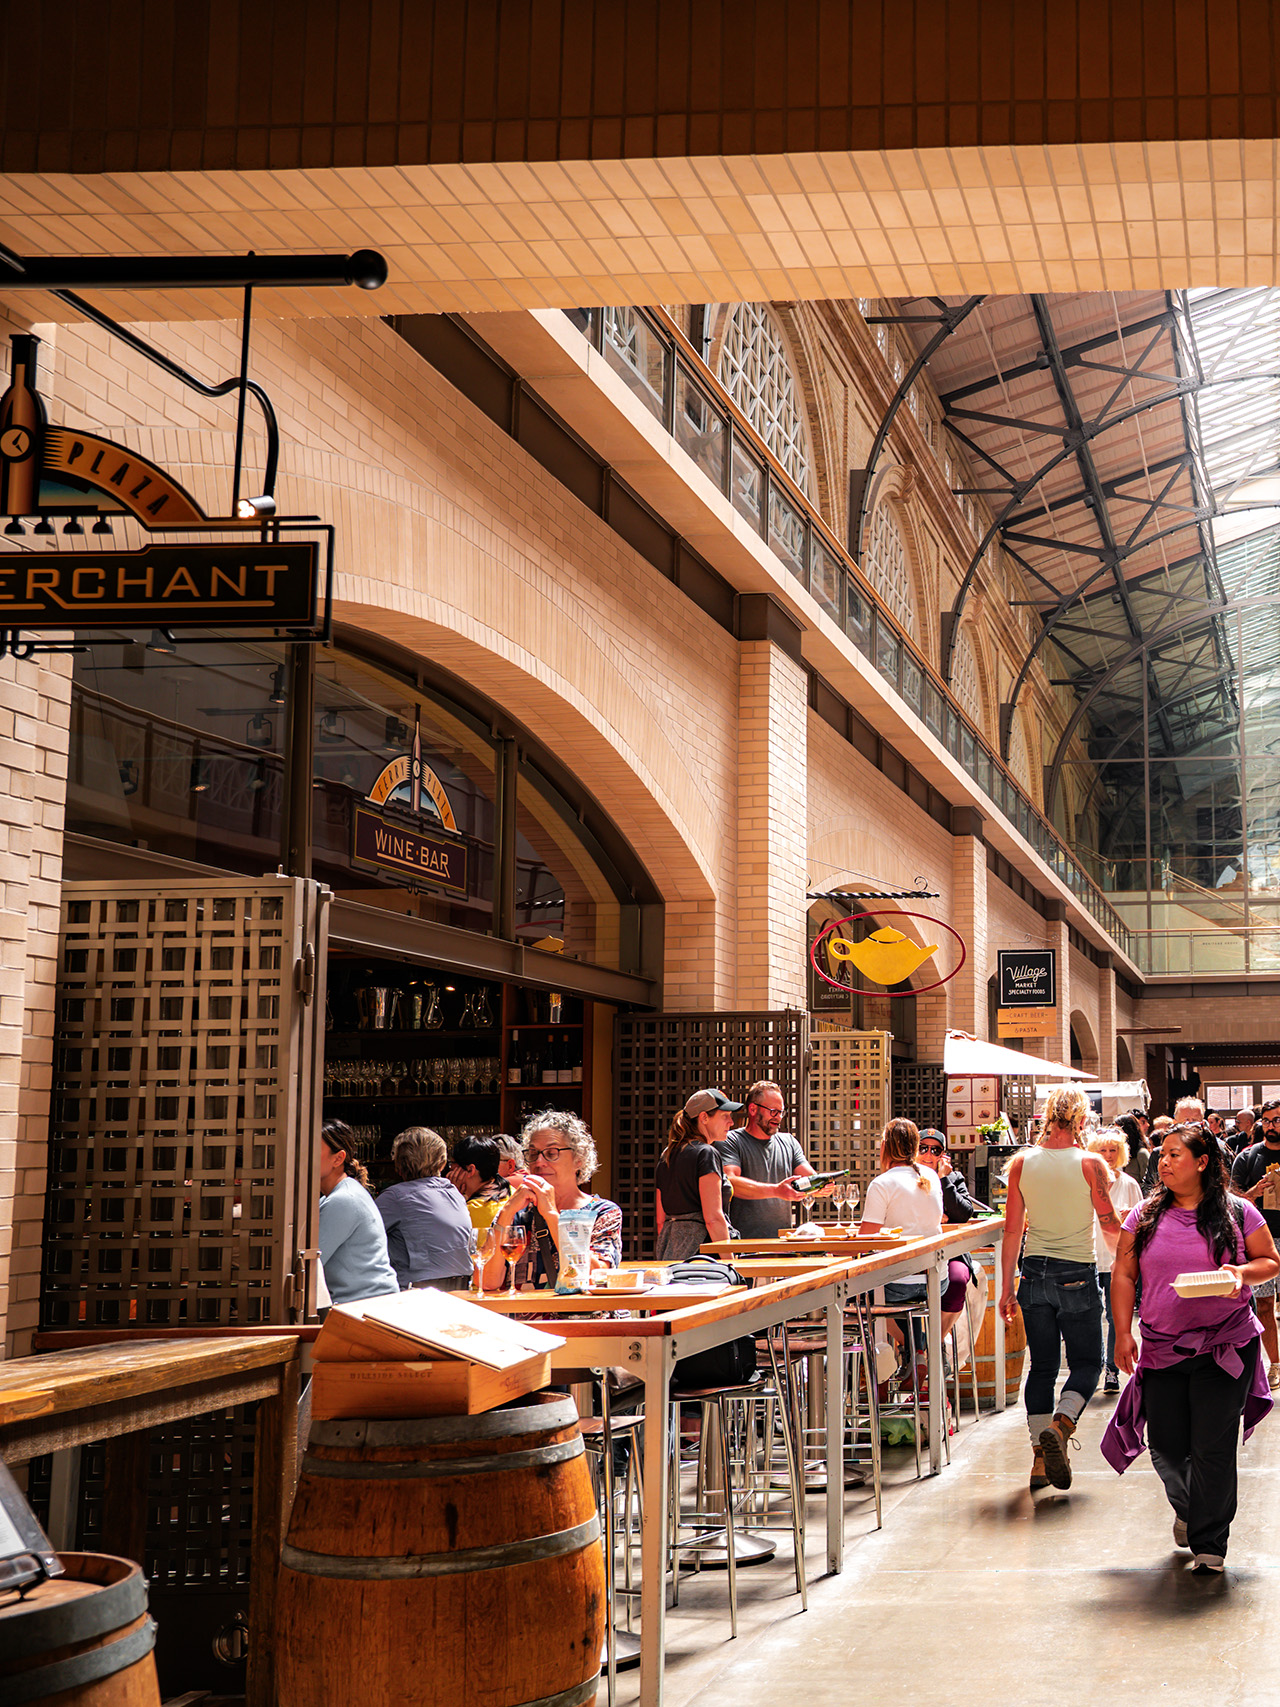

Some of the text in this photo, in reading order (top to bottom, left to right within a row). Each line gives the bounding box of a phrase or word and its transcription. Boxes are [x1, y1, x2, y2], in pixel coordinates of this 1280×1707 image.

[66, 440, 170, 516] PLAZA
[377, 760, 405, 799] FERRY
[427, 772, 450, 823] PLAZA
[375, 829, 451, 879] WINE BAR
[1005, 964, 1048, 982] Village
[350, 1372, 393, 1380] HILLSIDE
